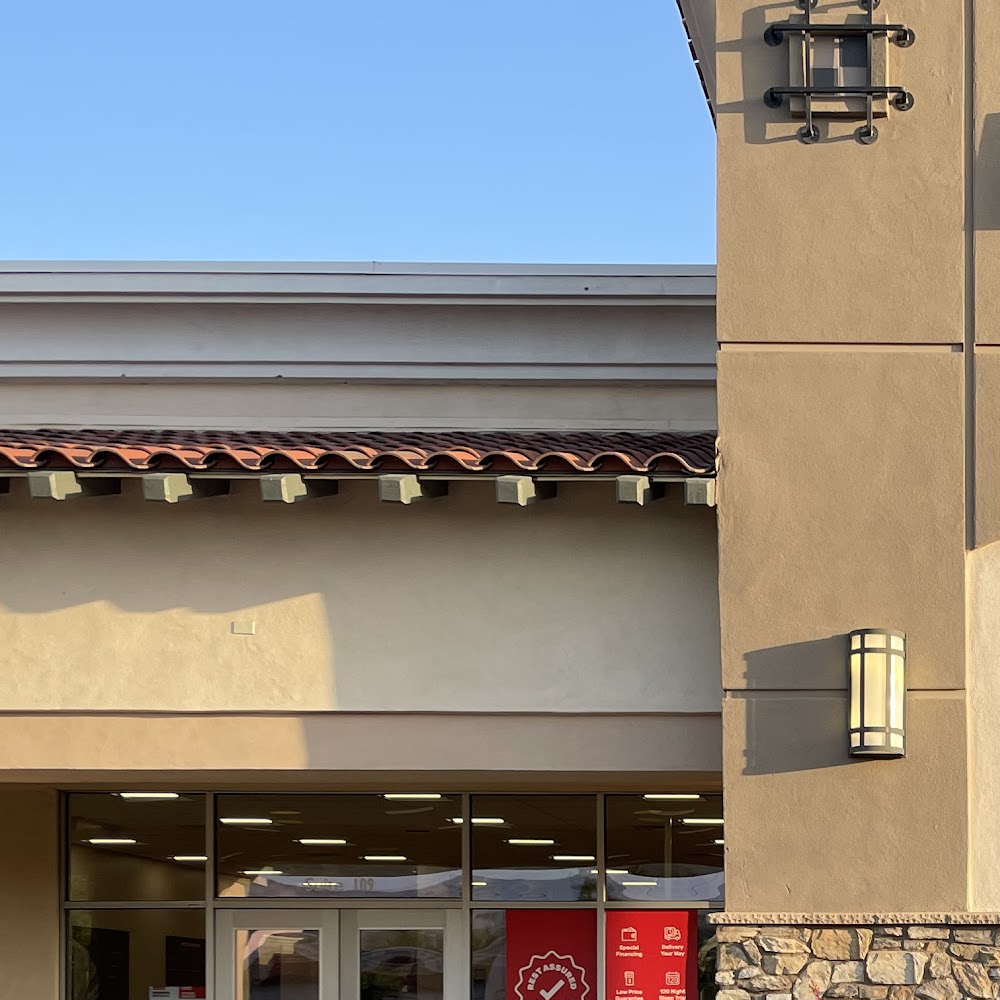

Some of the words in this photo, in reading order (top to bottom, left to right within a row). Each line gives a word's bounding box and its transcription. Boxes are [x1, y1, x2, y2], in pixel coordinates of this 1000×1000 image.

[354, 878, 374, 891] 109
[527, 967, 542, 990] REST
[543, 963, 577, 990] ASSURED
